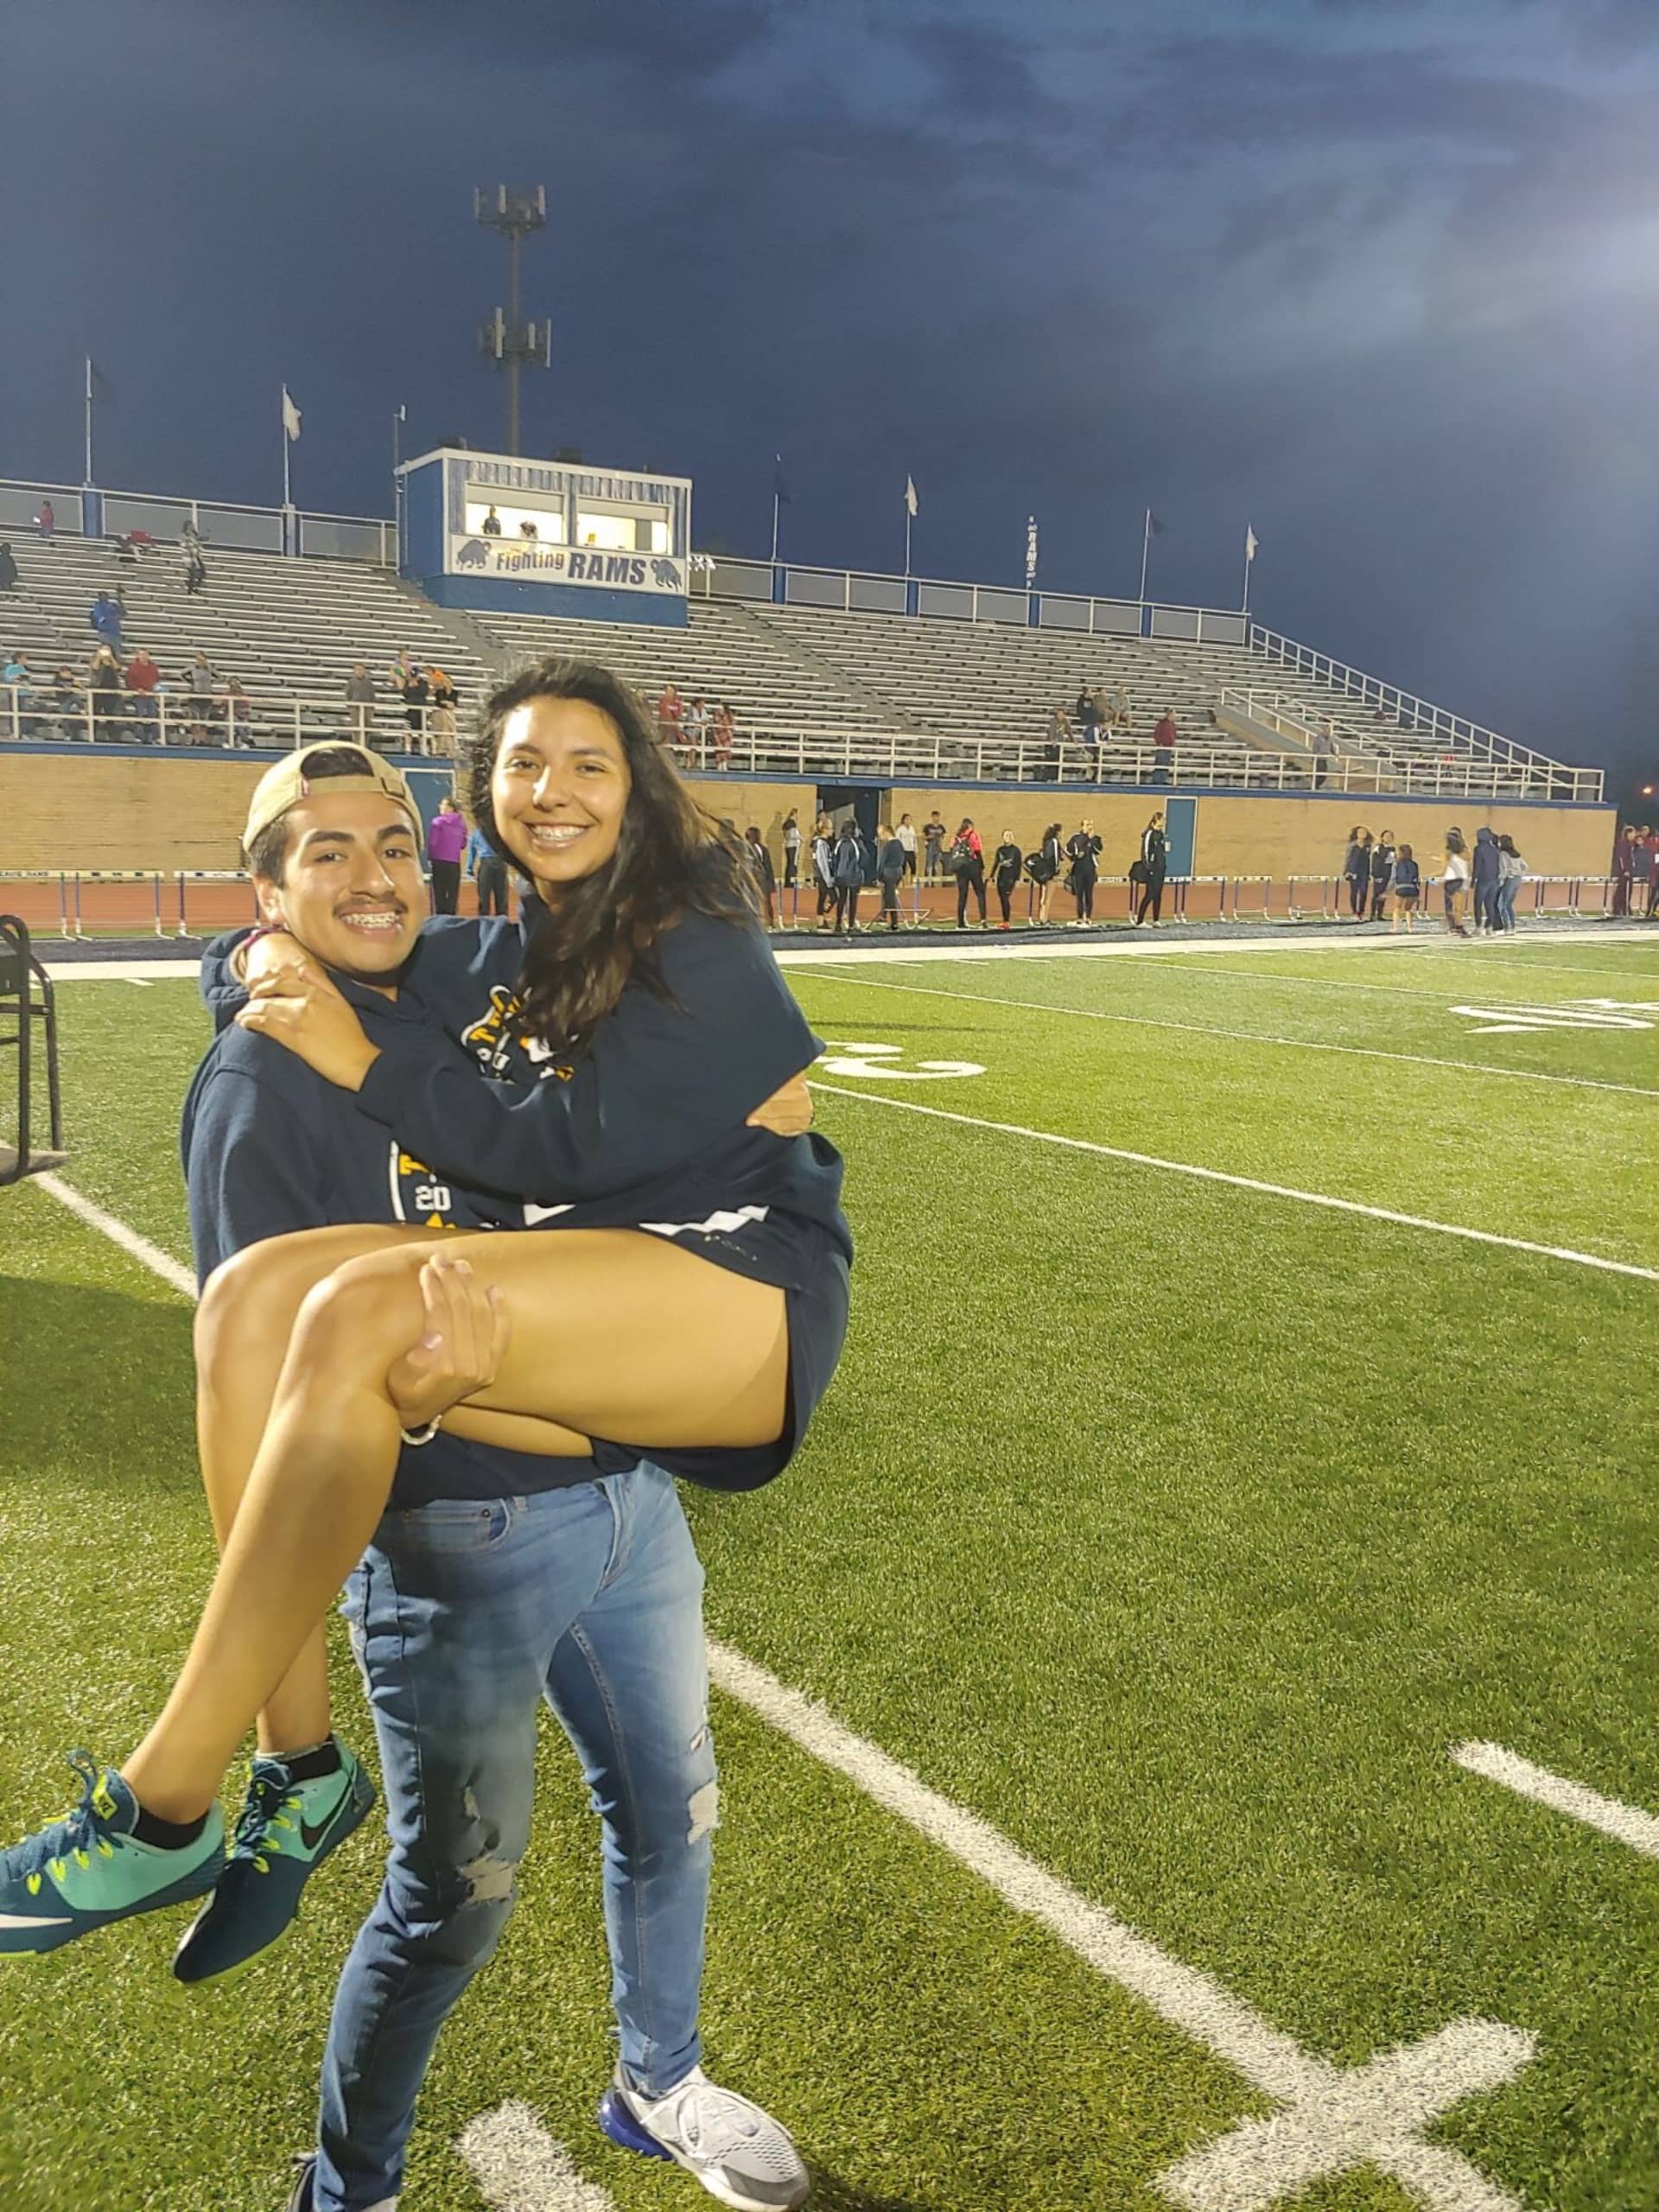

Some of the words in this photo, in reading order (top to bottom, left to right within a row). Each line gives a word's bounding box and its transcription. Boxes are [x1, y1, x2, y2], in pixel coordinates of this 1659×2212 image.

[497, 551, 564, 572] Fighting
[569, 552, 645, 585] RAMS
[415, 1185, 451, 1211] 20
